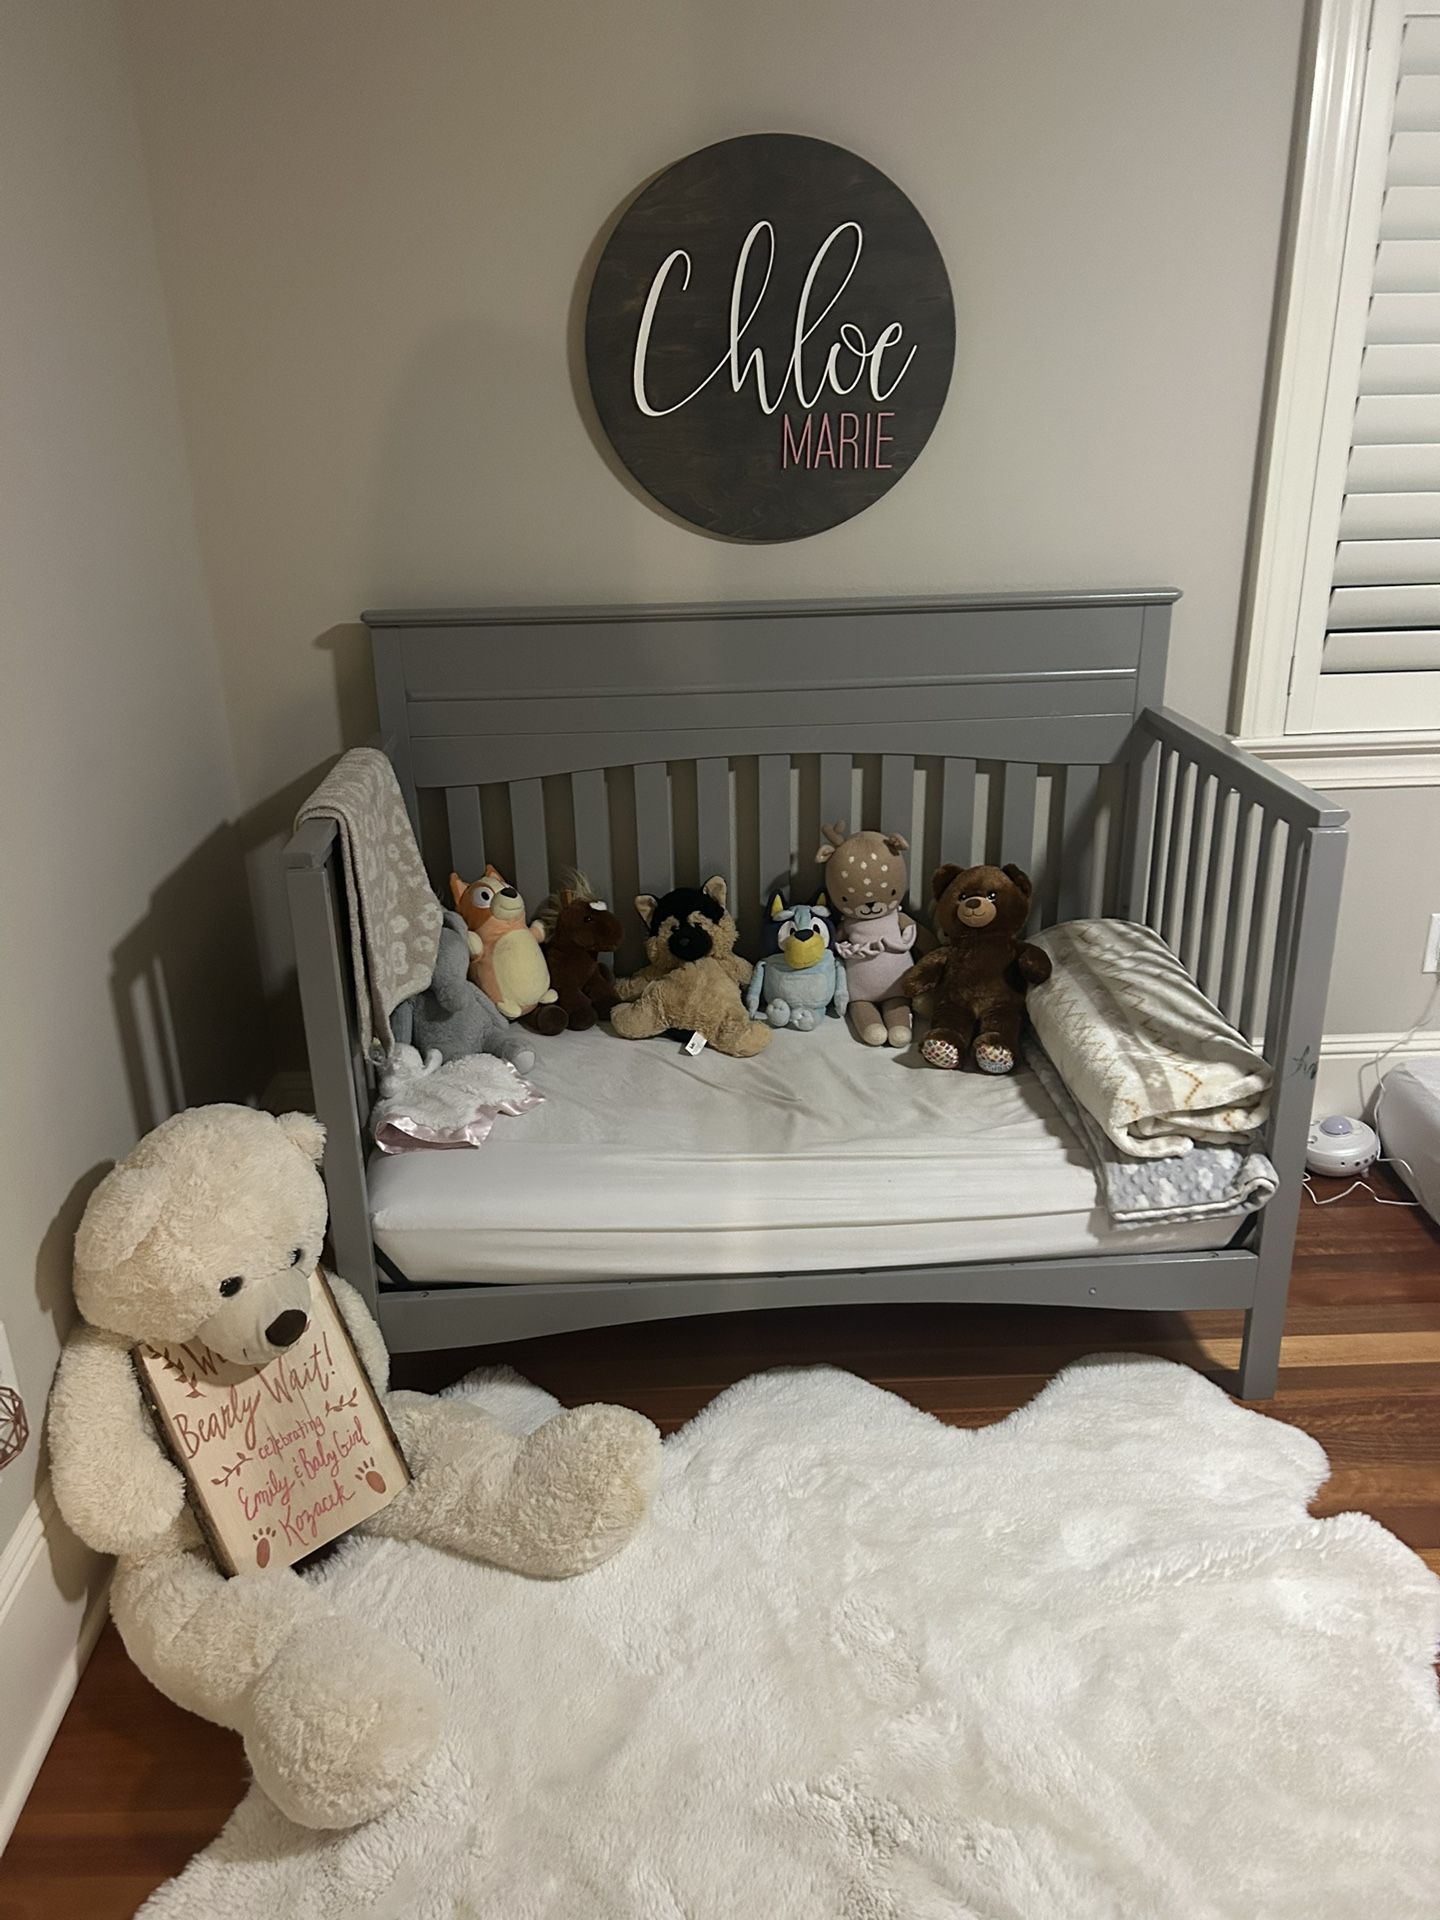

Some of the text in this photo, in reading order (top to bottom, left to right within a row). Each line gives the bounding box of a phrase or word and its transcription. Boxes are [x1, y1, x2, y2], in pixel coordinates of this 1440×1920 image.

[633, 220, 919, 418] Chloe
[782, 411, 896, 470] MARIE
[172, 1384, 261, 1460] Bearly
[254, 1330, 336, 1404] Wait!
[258, 1415, 326, 1460] celebrating
[238, 1469, 296, 1521] Emily
[298, 1439, 340, 1480] Baby
[332, 1415, 371, 1459] Girl
